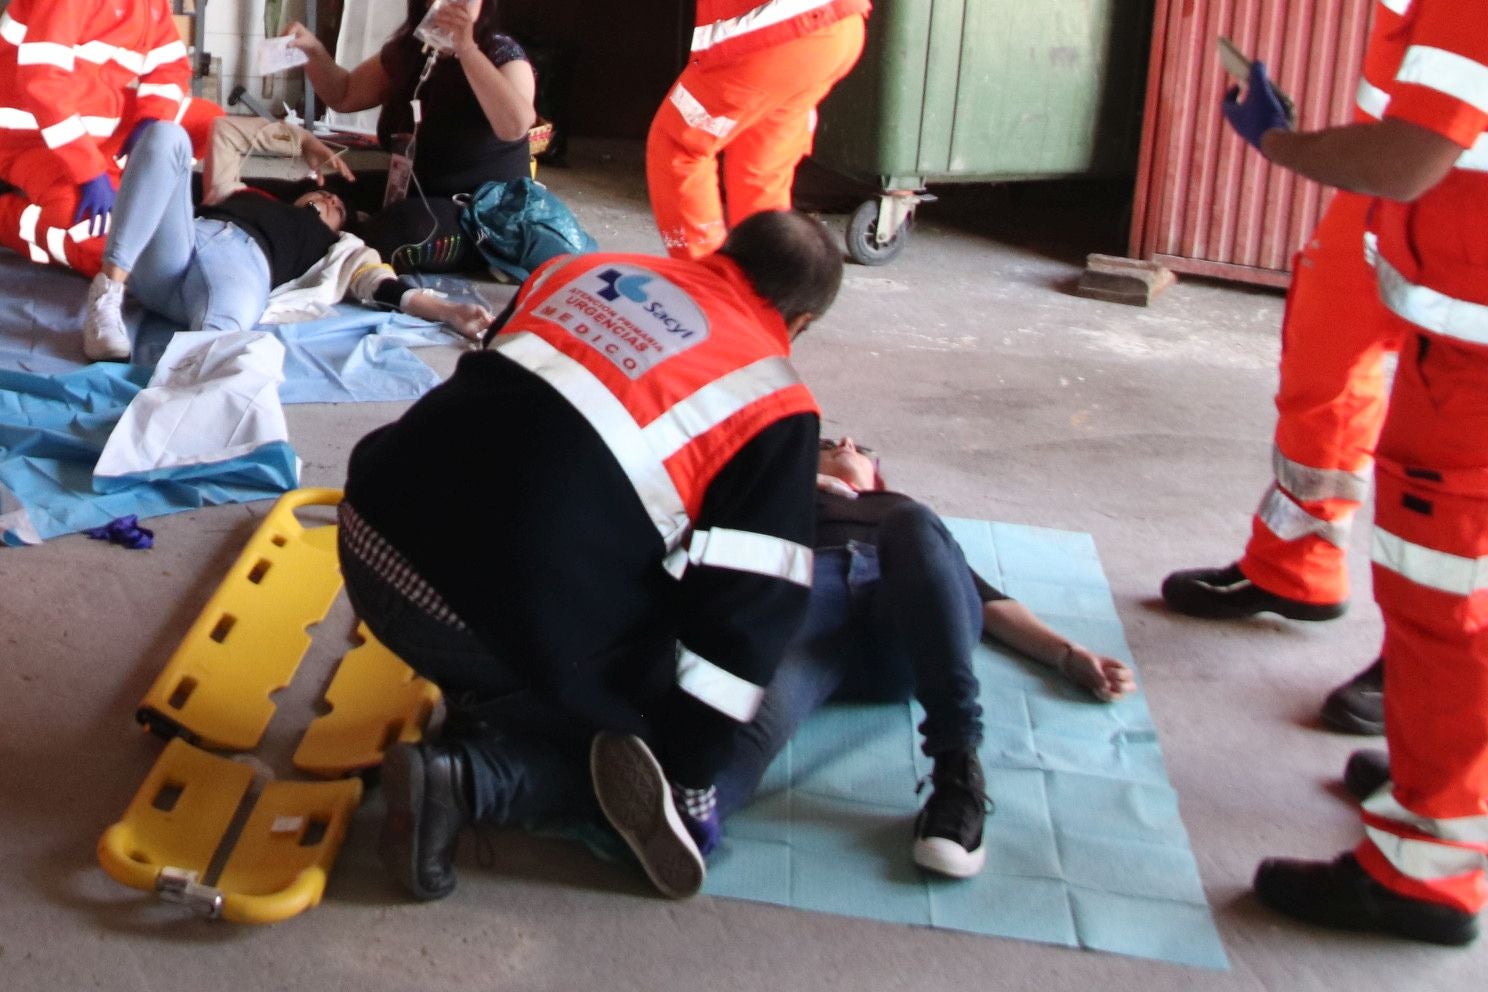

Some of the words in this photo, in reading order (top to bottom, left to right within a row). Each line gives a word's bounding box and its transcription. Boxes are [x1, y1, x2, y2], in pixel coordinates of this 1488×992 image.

[540, 305, 637, 370] MEDICO
[565, 295, 649, 353] URGENCIAS
[617, 316, 663, 352] PRIMARIA
[642, 301, 694, 340] Sacyl
